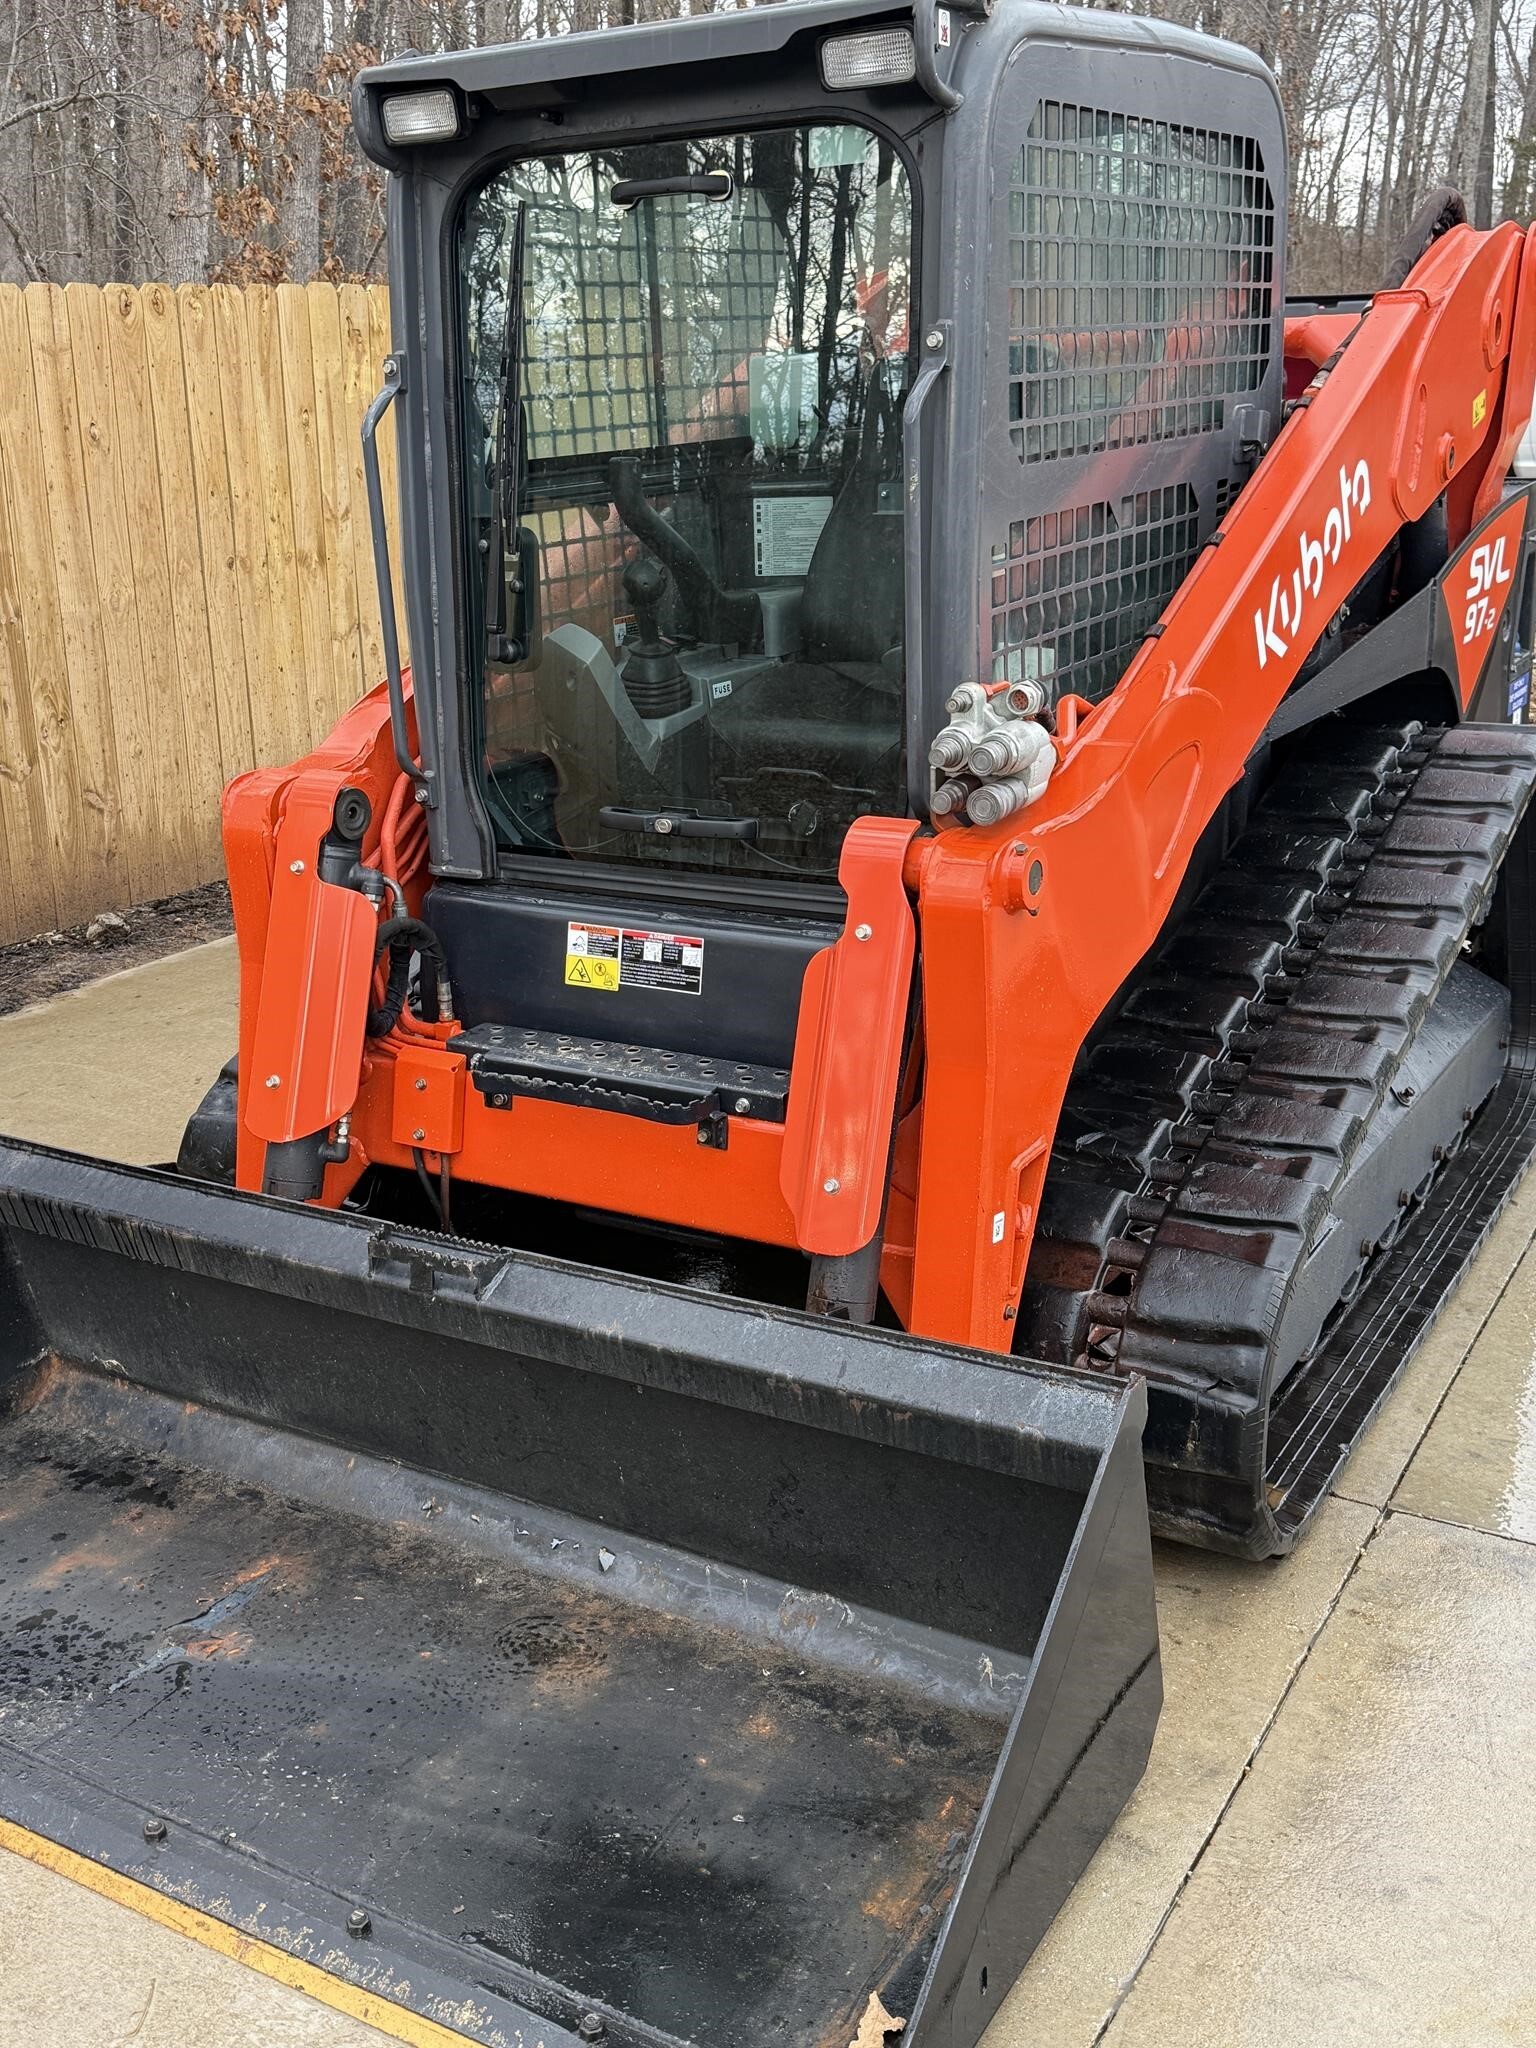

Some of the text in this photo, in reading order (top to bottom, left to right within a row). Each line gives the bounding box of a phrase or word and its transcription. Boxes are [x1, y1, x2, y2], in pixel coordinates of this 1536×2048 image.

[1254, 459, 1371, 670] Kubota
[1466, 536, 1510, 600] SVL
[1463, 596, 1496, 645] 97-2
[714, 684, 731, 694] FUSE
